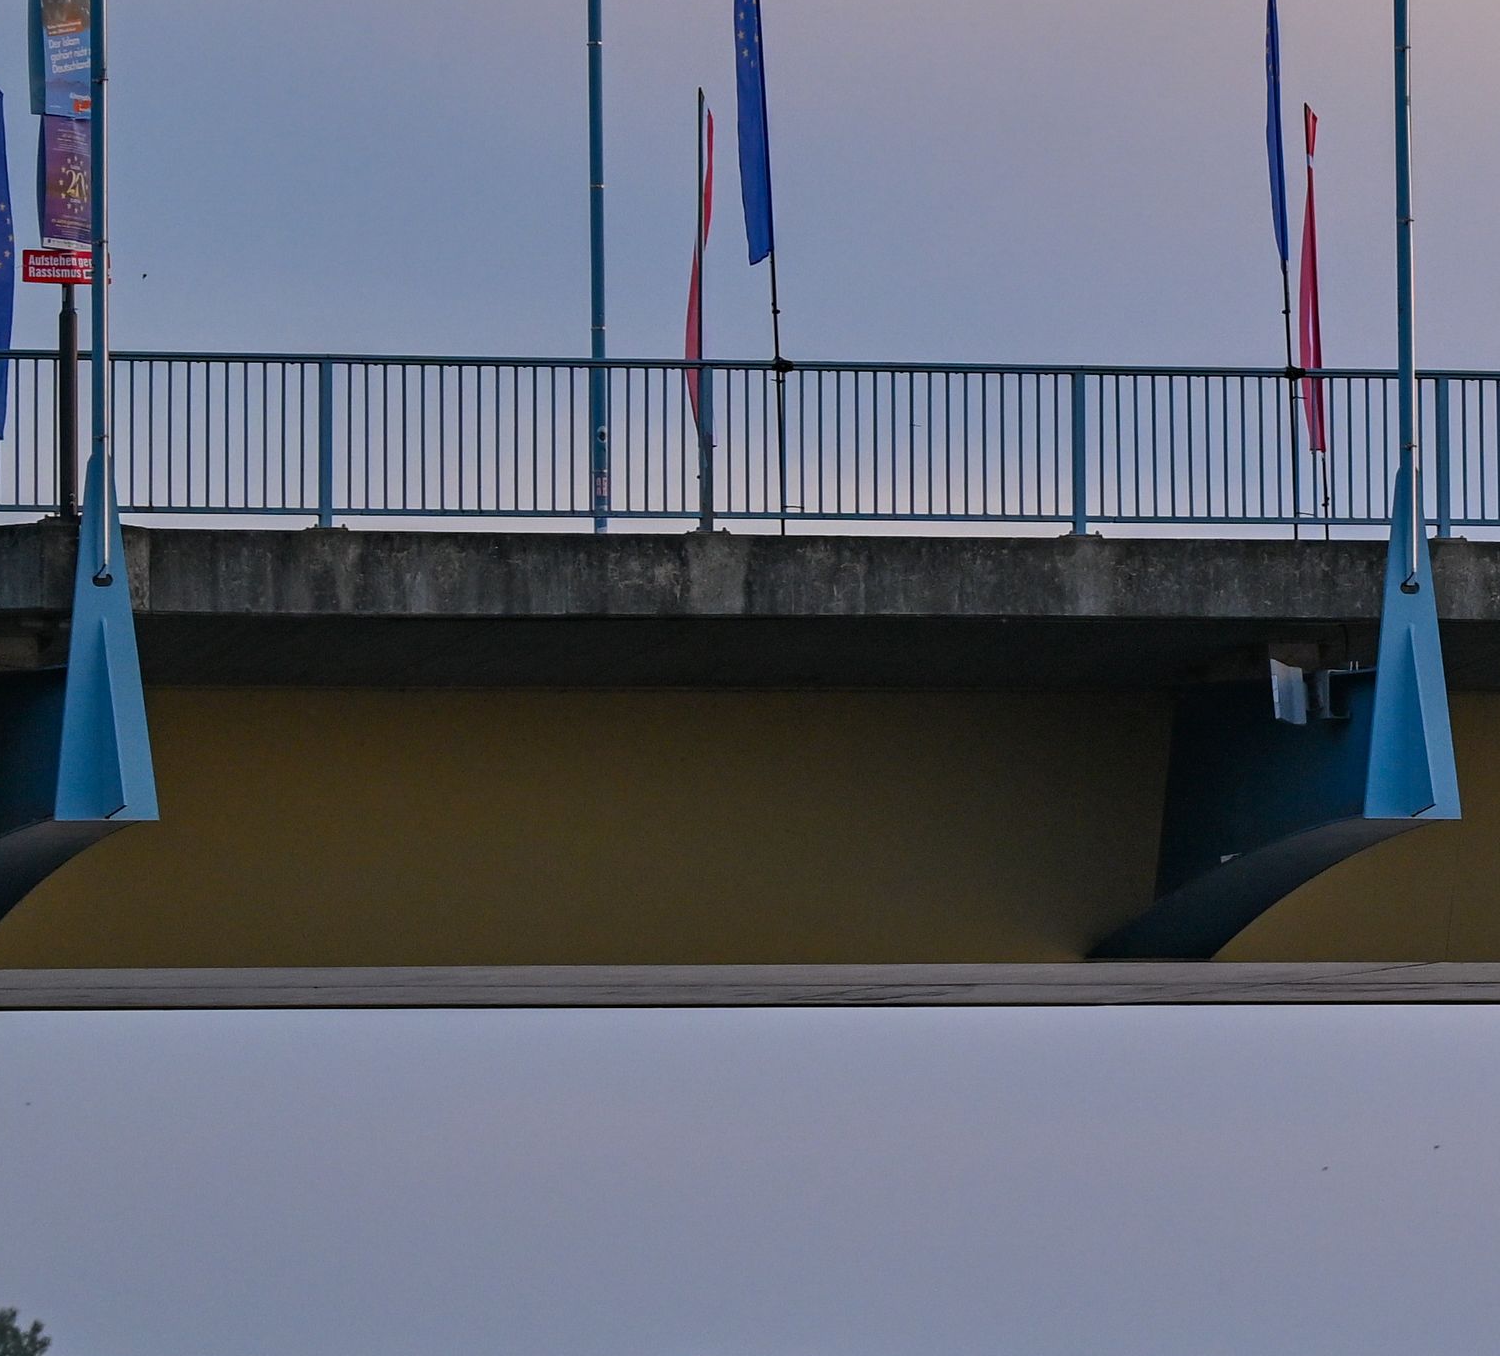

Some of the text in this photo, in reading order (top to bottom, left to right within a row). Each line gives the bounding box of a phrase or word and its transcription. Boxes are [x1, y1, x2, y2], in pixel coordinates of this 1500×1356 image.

[62, 36, 79, 47] Islam
[29, 255, 77, 266] Aufstehen
[29, 267, 81, 278] Rassismus
